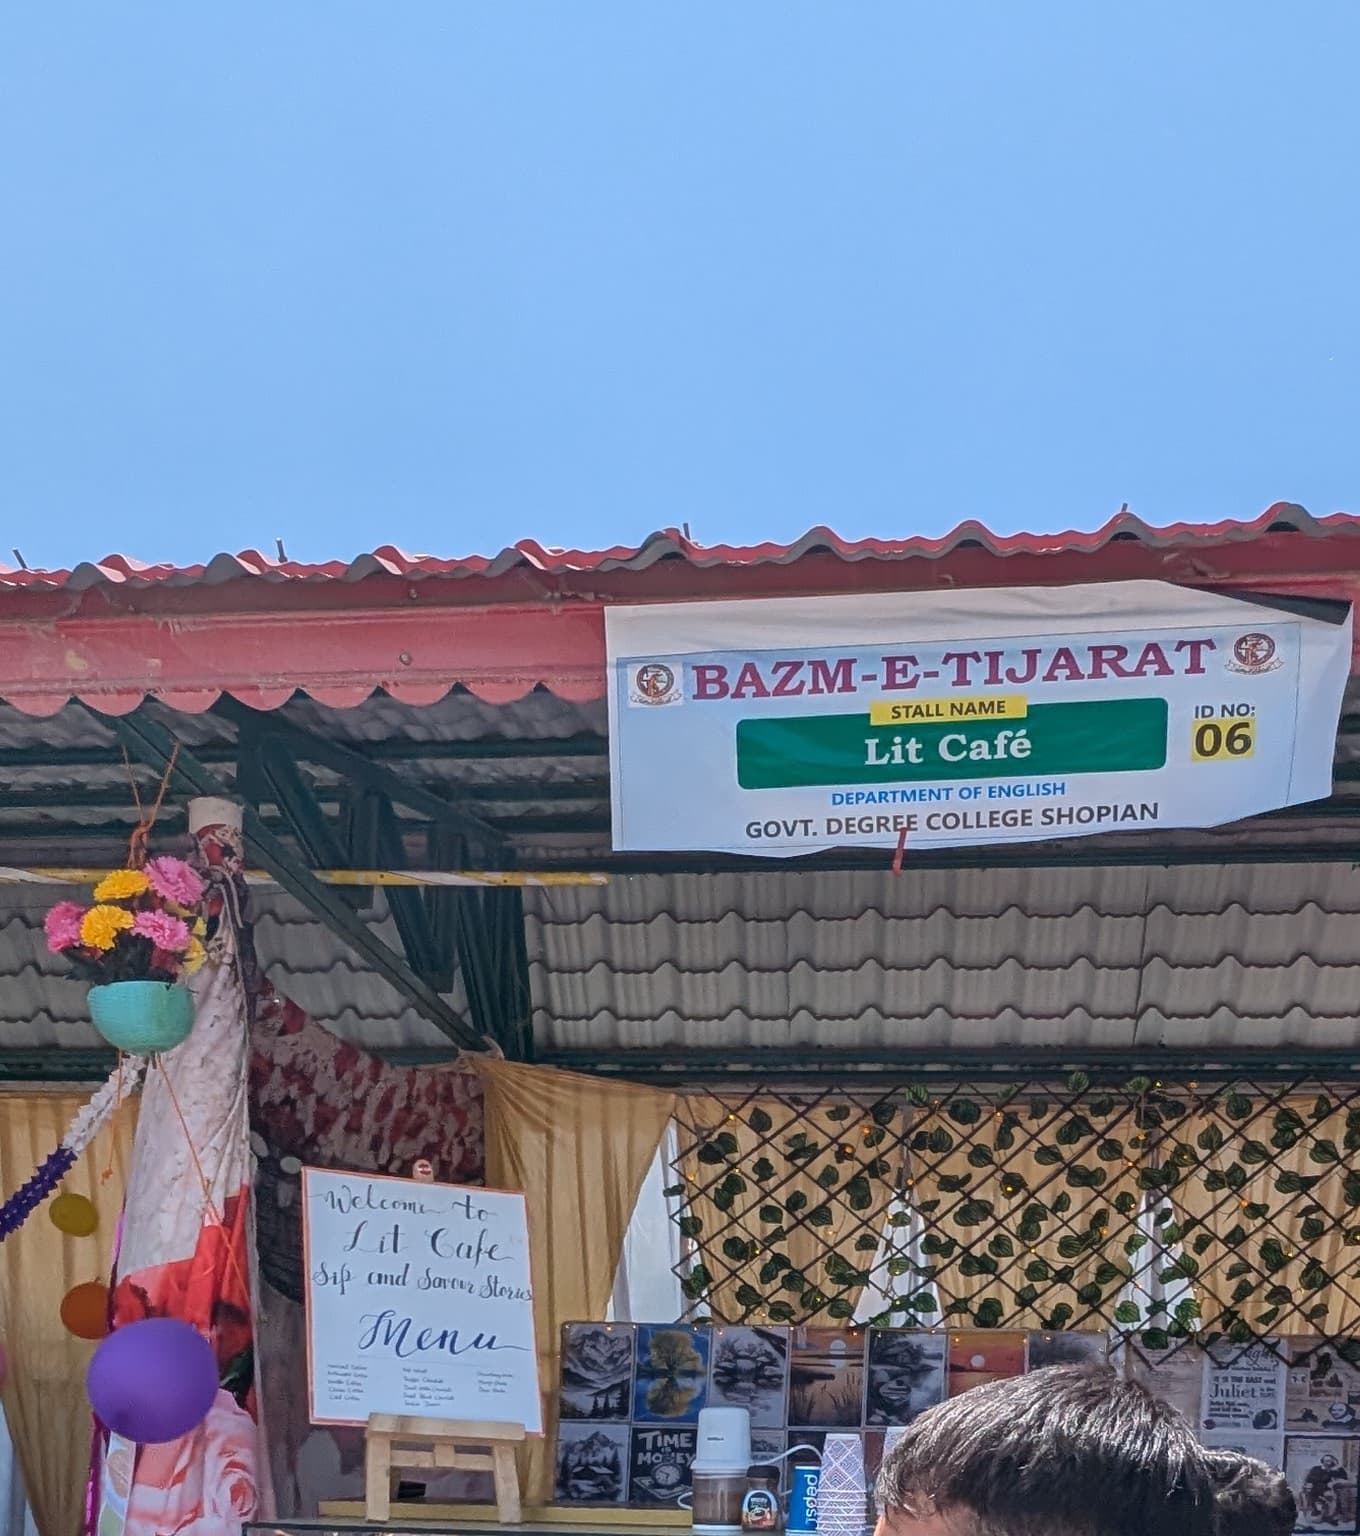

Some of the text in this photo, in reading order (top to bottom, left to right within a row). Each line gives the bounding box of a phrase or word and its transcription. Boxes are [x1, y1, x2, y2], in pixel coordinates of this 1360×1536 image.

[692, 638, 1217, 700] BAZM-E-TIJARAT
[890, 699, 1007, 720] STALL NAME
[1194, 702, 1256, 720] ID NO:
[864, 728, 1033, 766] Lit Café
[1194, 721, 1253, 758] 06
[831, 782, 1066, 806] DEPARTMENT OF ENGLISH
[745, 802, 1159, 839] GOVT. DEGREE COLLEGE SHOPIAN
[309, 1184, 499, 1222] Welcome to
[343, 1220, 515, 1268] Lit Cafe
[312, 1261, 356, 1296] Sip
[367, 1263, 410, 1288] and
[358, 1310, 534, 1359] Menu
[1210, 1383, 1257, 1399] Juliet
[637, 1430, 693, 1451] TIME
